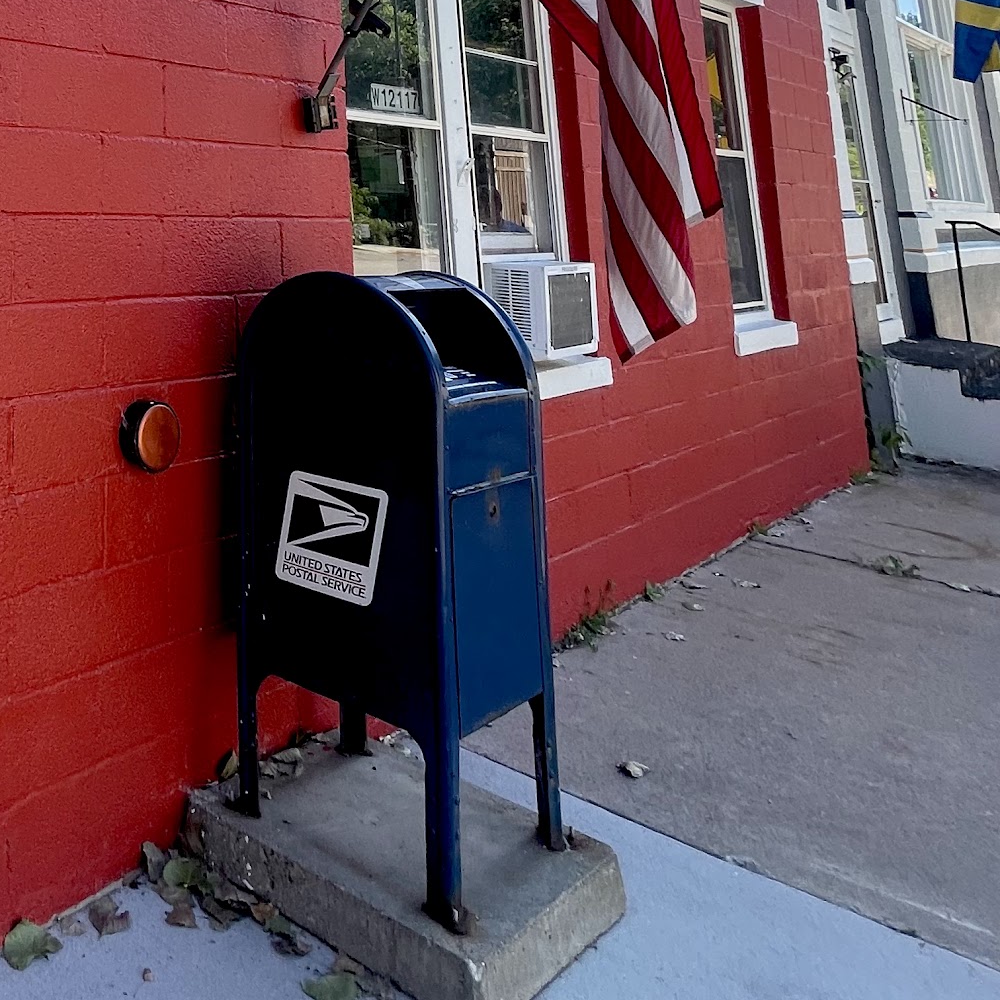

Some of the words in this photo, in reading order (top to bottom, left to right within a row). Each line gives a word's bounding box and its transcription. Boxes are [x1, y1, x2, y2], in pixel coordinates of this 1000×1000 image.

[282, 563, 320, 585] POSTAL
[321, 575, 367, 600] SERVICE
[284, 550, 323, 571] UNITED
[323, 564, 363, 584] STATES
